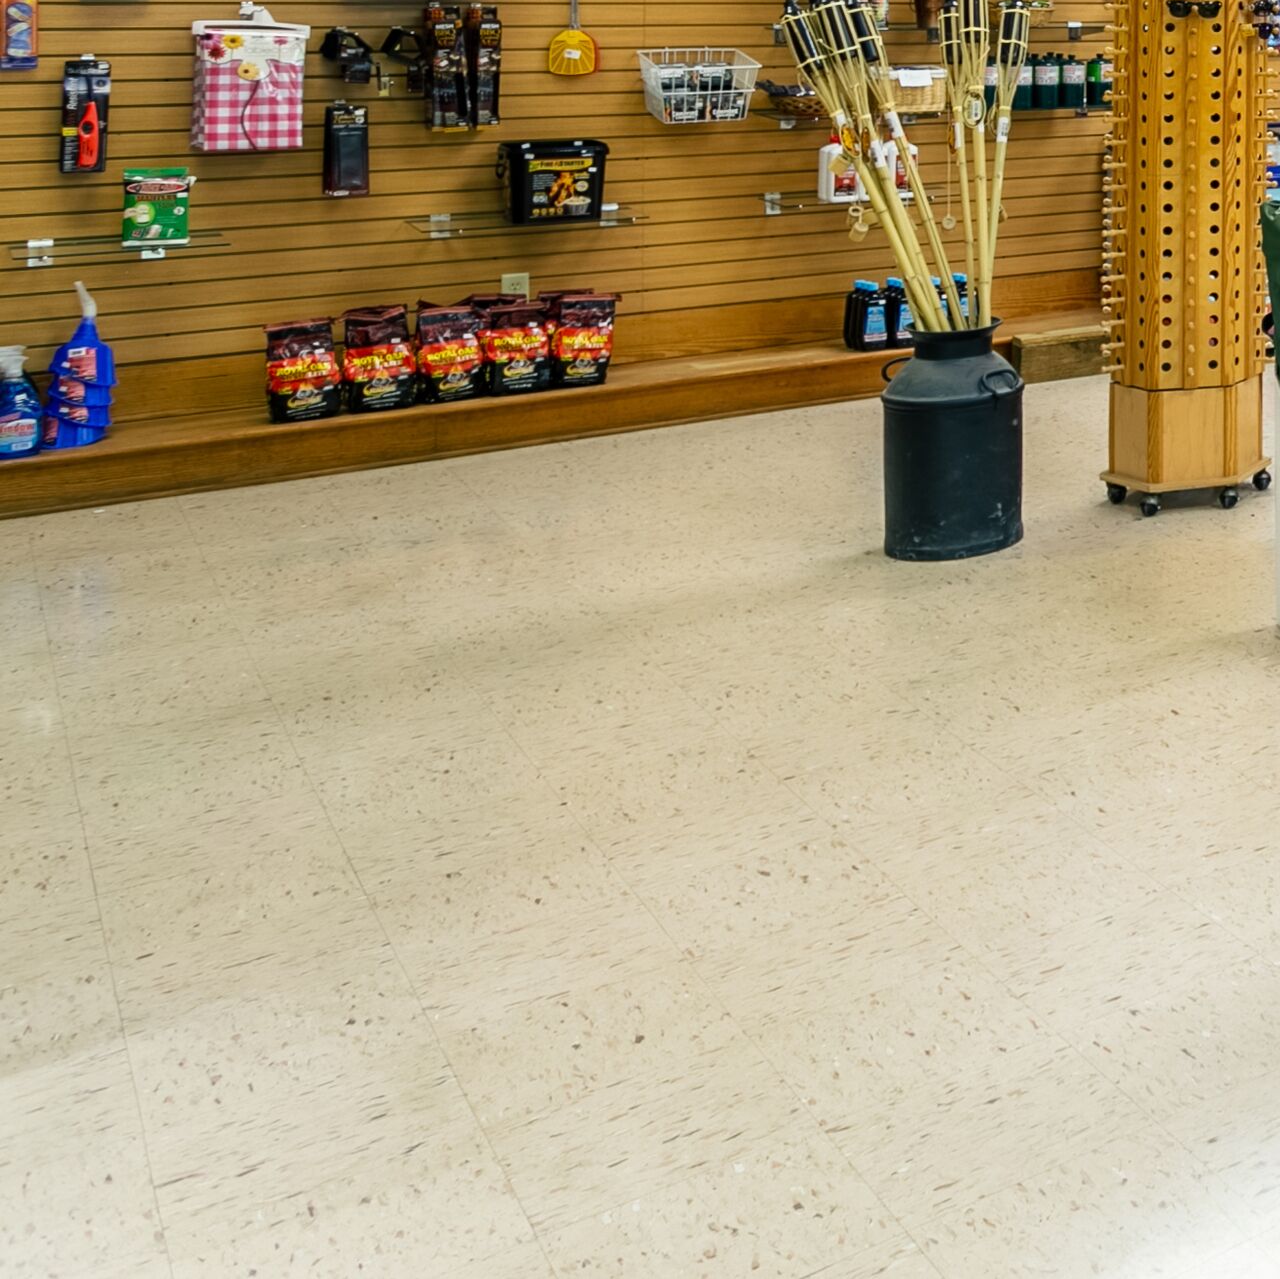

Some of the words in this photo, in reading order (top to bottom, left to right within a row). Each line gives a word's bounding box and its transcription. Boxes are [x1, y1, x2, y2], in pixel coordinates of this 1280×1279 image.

[427, 349, 456, 361] ROYAL
[352, 356, 384, 367] ROYAL
[276, 364, 309, 376] ROYAL
